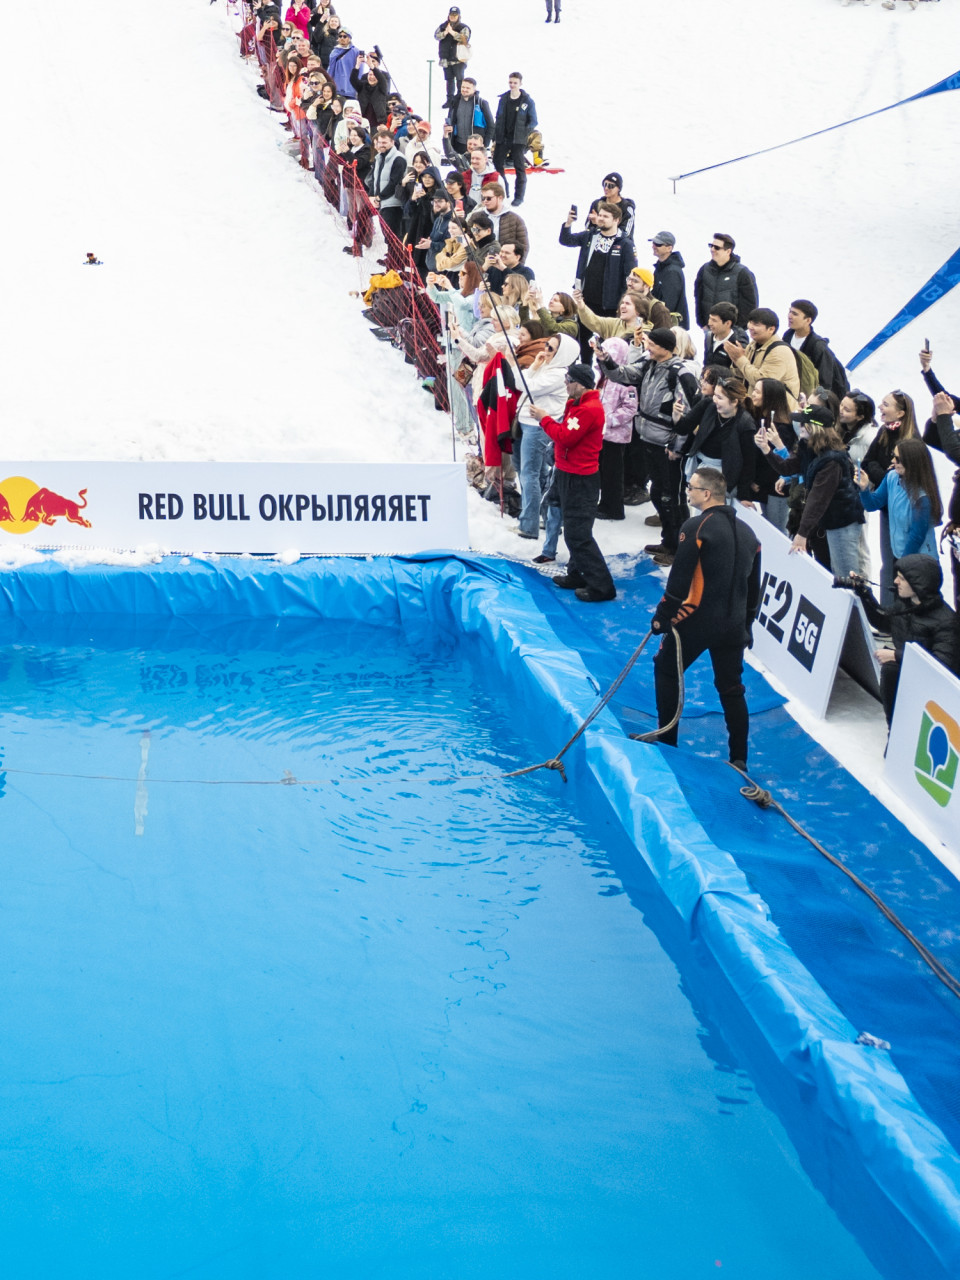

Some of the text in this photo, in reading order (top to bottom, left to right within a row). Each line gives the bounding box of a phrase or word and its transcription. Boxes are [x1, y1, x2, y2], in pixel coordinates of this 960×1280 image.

[138, 492, 431, 522] RED BULL ОКРЫЛЯЯЯЕТ
[795, 613, 818, 654] 5G
